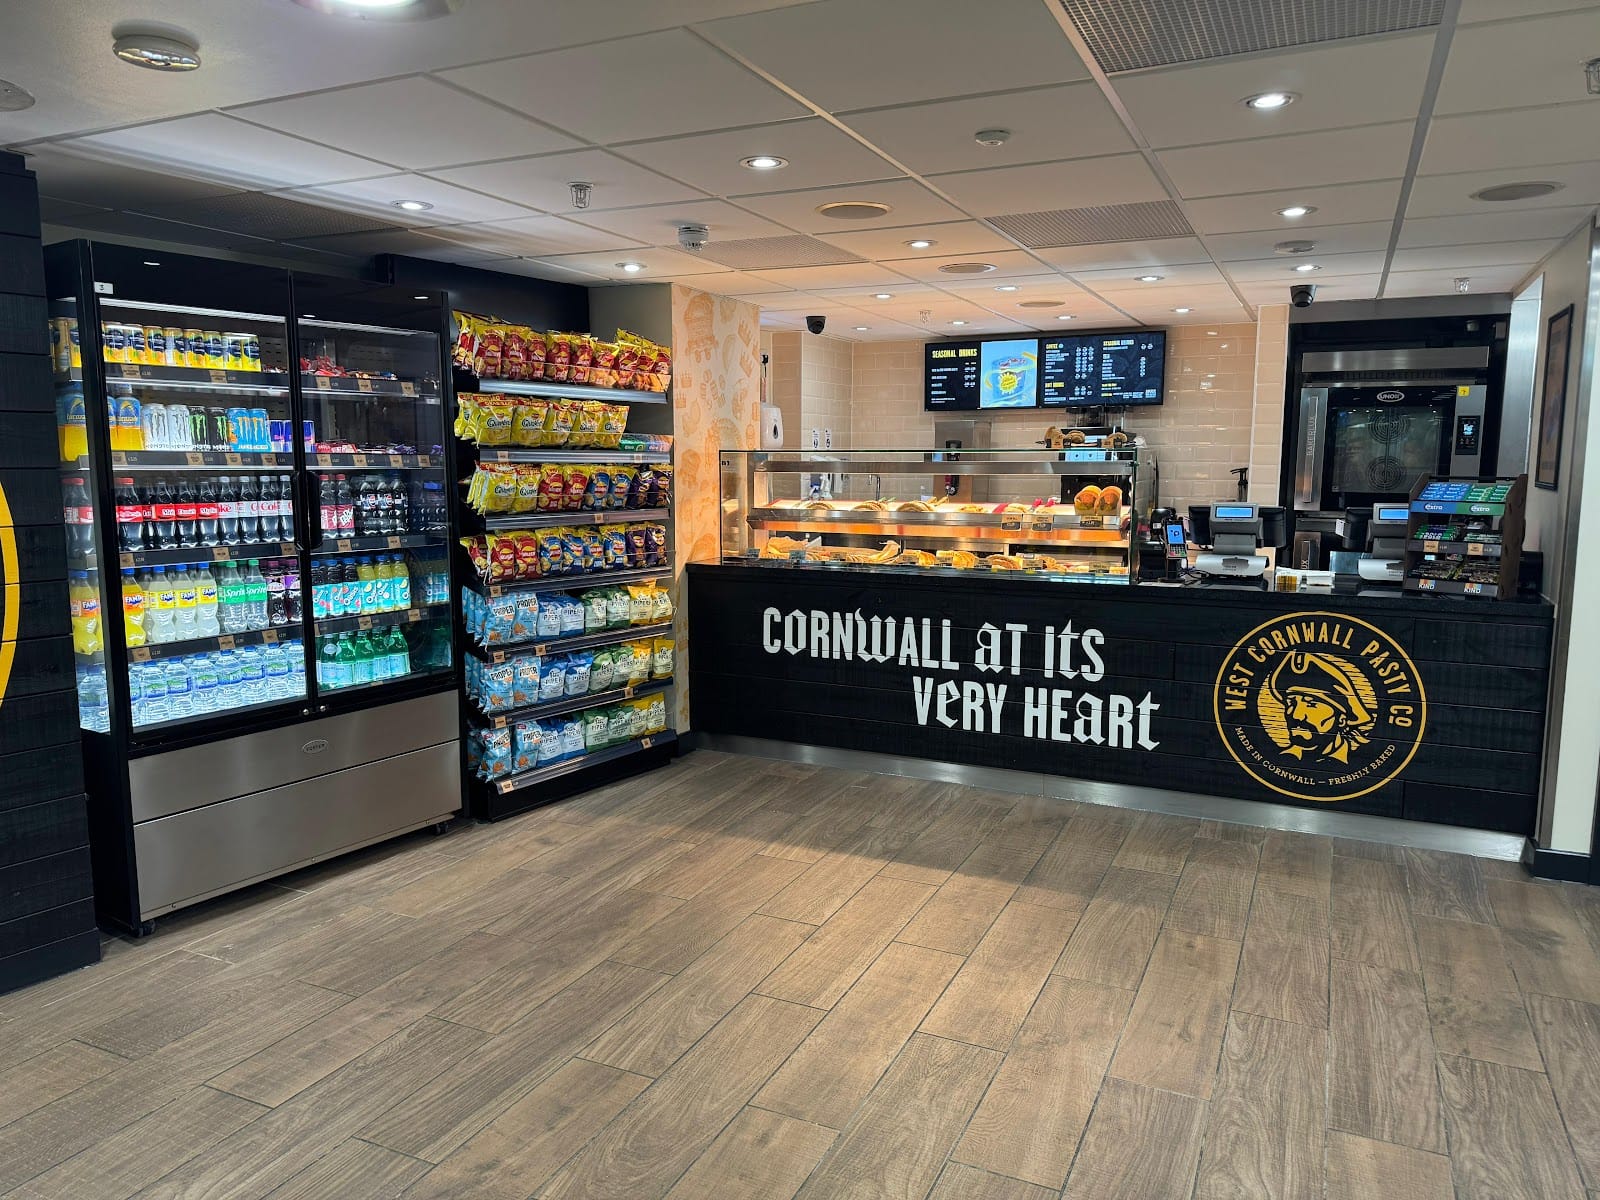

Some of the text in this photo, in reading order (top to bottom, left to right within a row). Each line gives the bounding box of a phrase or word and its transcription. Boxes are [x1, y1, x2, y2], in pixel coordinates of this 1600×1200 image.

[516, 597, 537, 608] PROPER
[1224, 662, 1256, 711] WEST
[1247, 621, 1354, 663] CORNWALL
[1359, 639, 1412, 694] PASTY
[1235, 726, 1396, 786] MADE IN CORNWALL FRESHLY BAKED
